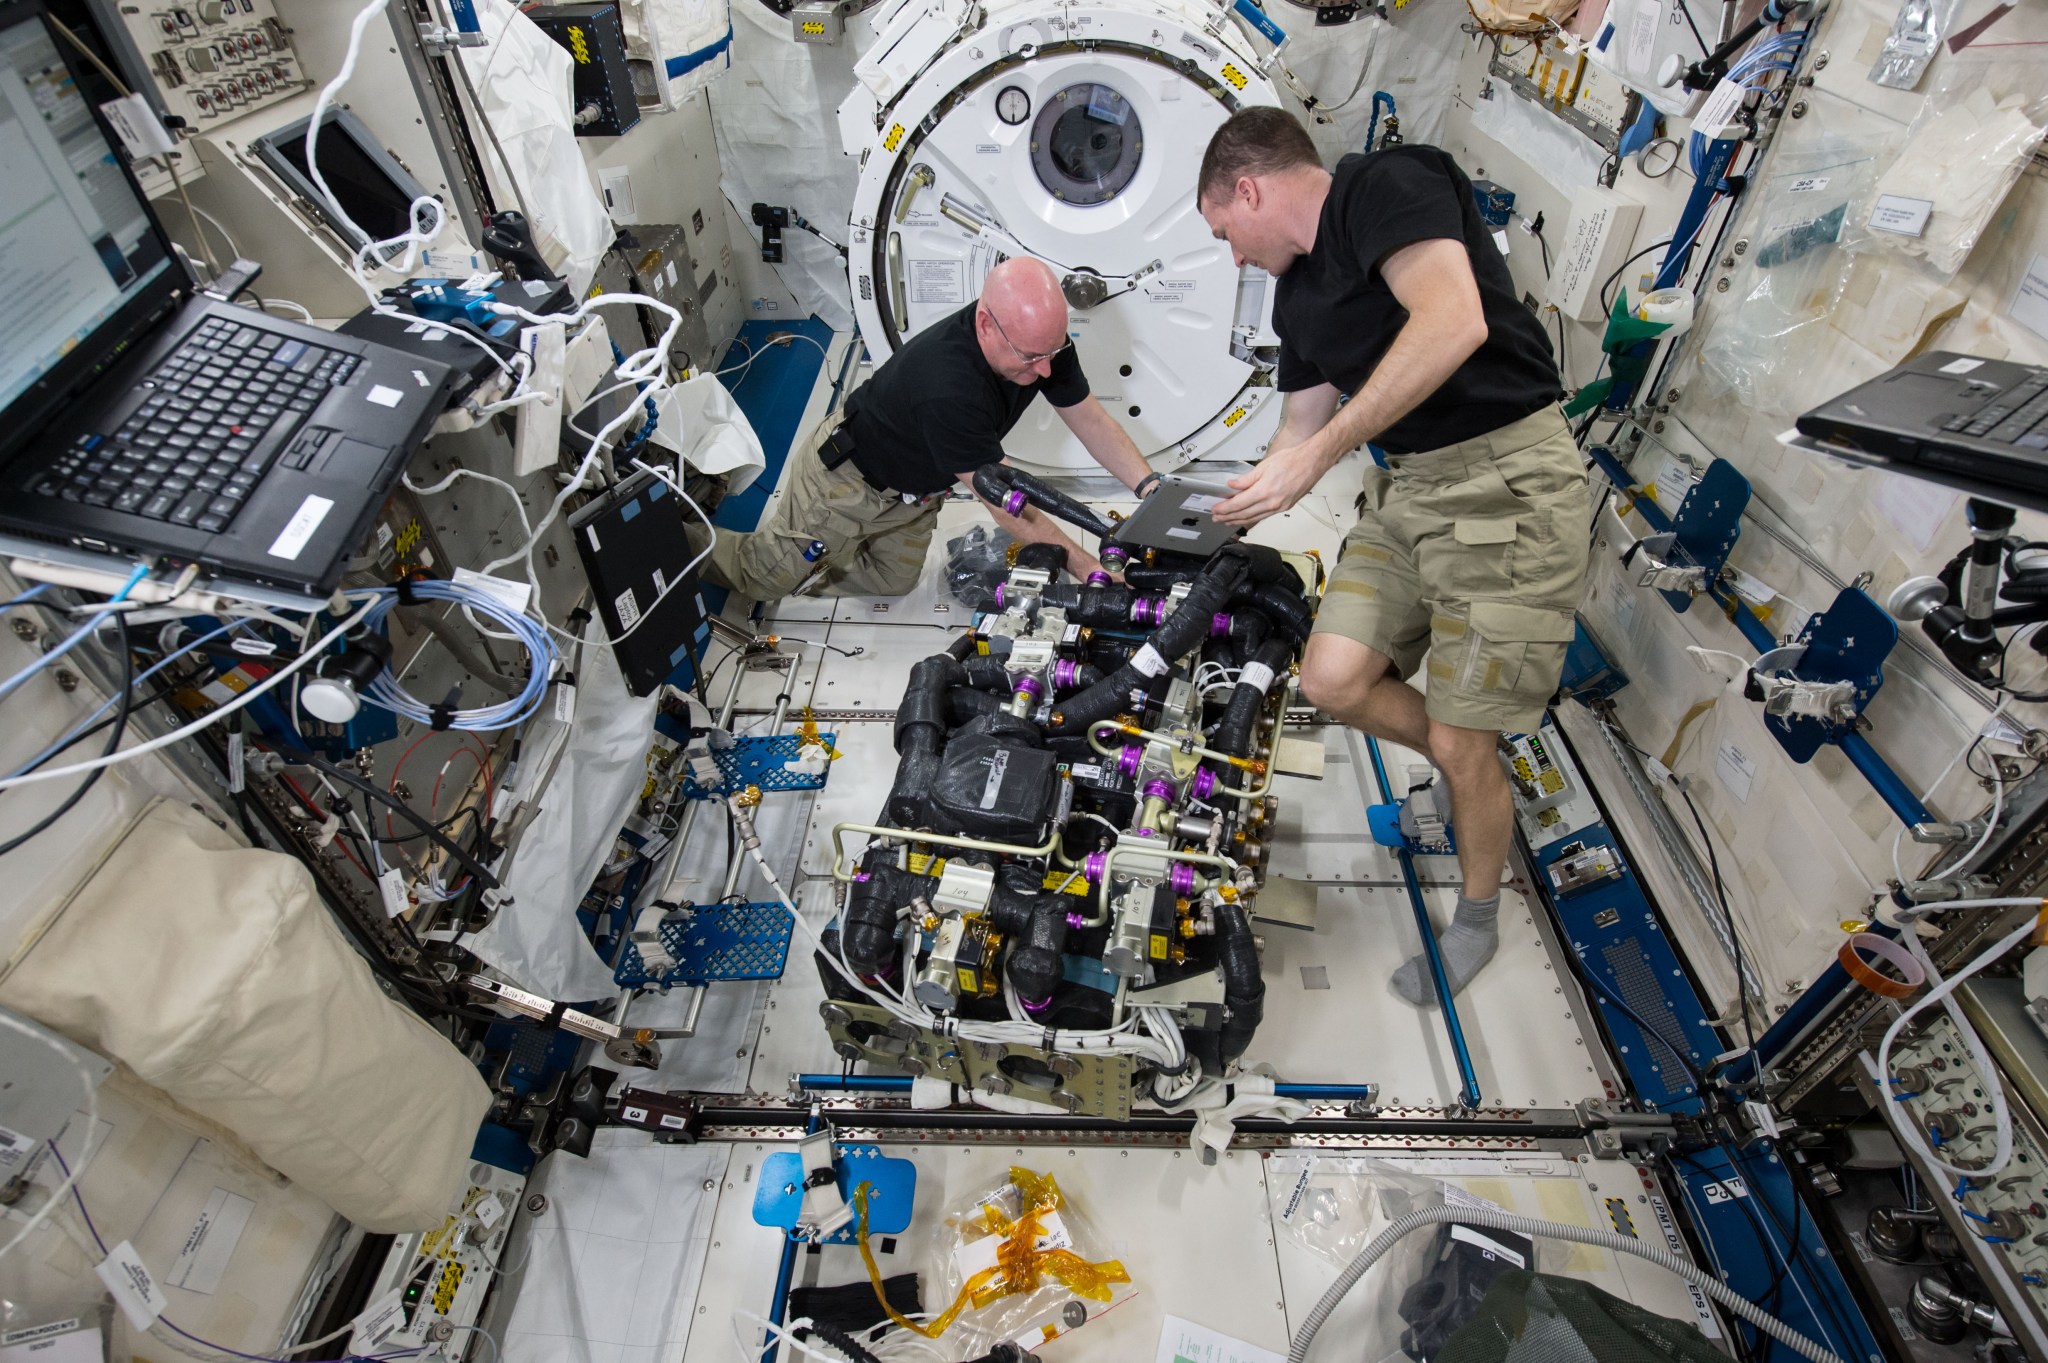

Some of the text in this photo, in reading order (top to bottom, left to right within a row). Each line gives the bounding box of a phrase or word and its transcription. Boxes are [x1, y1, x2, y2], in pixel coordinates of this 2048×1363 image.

[617, 604, 627, 624] JAXA
[621, 597, 632, 622] Laptop
[627, 593, 639, 617] MSPR
[1282, 1169, 1309, 1220] Adjustable Bungee
[1705, 1186, 1718, 1197] D
[1727, 1179, 1742, 1188] F
[1652, 1198, 1681, 1250] JPM1 D5
[1689, 1284, 1710, 1319] EPS 2
